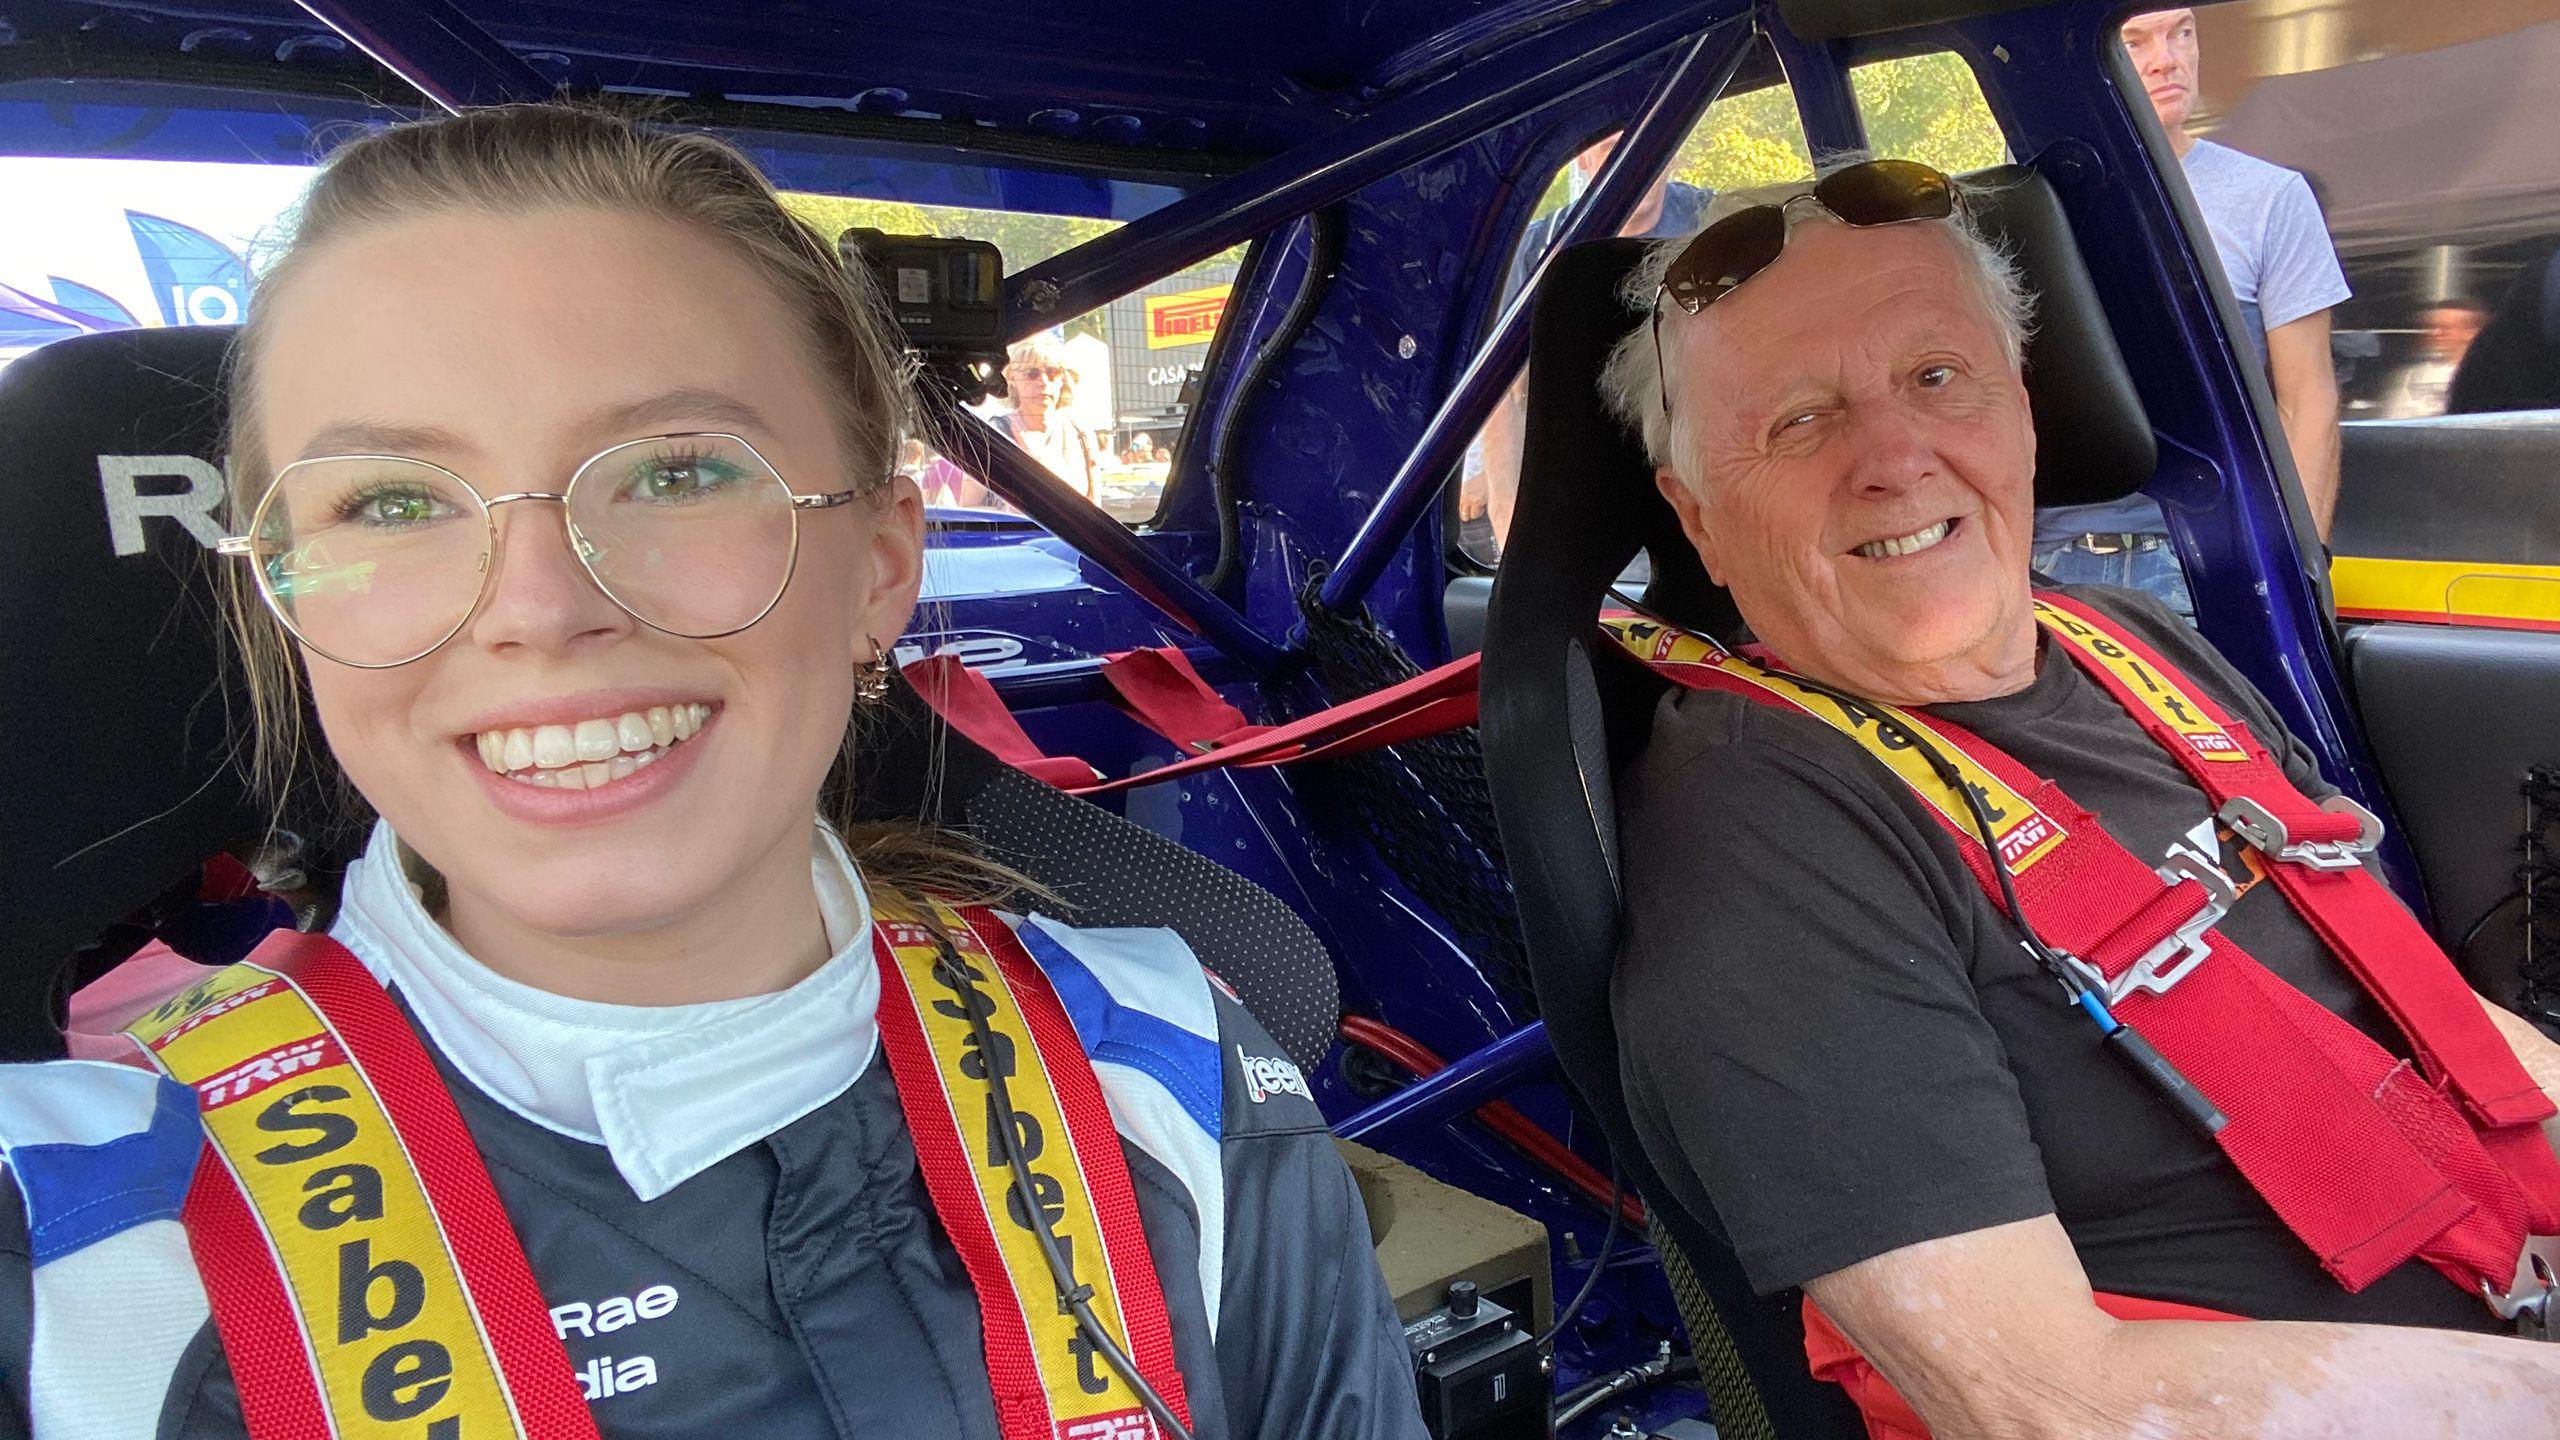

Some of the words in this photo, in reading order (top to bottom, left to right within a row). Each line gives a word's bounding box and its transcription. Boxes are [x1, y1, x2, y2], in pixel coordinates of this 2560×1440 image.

[1148, 364, 1187, 386] CASA
[97, 454, 233, 559] R
[2188, 733, 2233, 751] TRW
[1996, 817, 2048, 861] TRW
[164, 981, 276, 1045] TRW
[200, 1039, 327, 1106] TRW
[931, 953, 1110, 1395] Sabelt
[254, 1084, 461, 1440] Sabe
[549, 1284, 679, 1341] Rae
